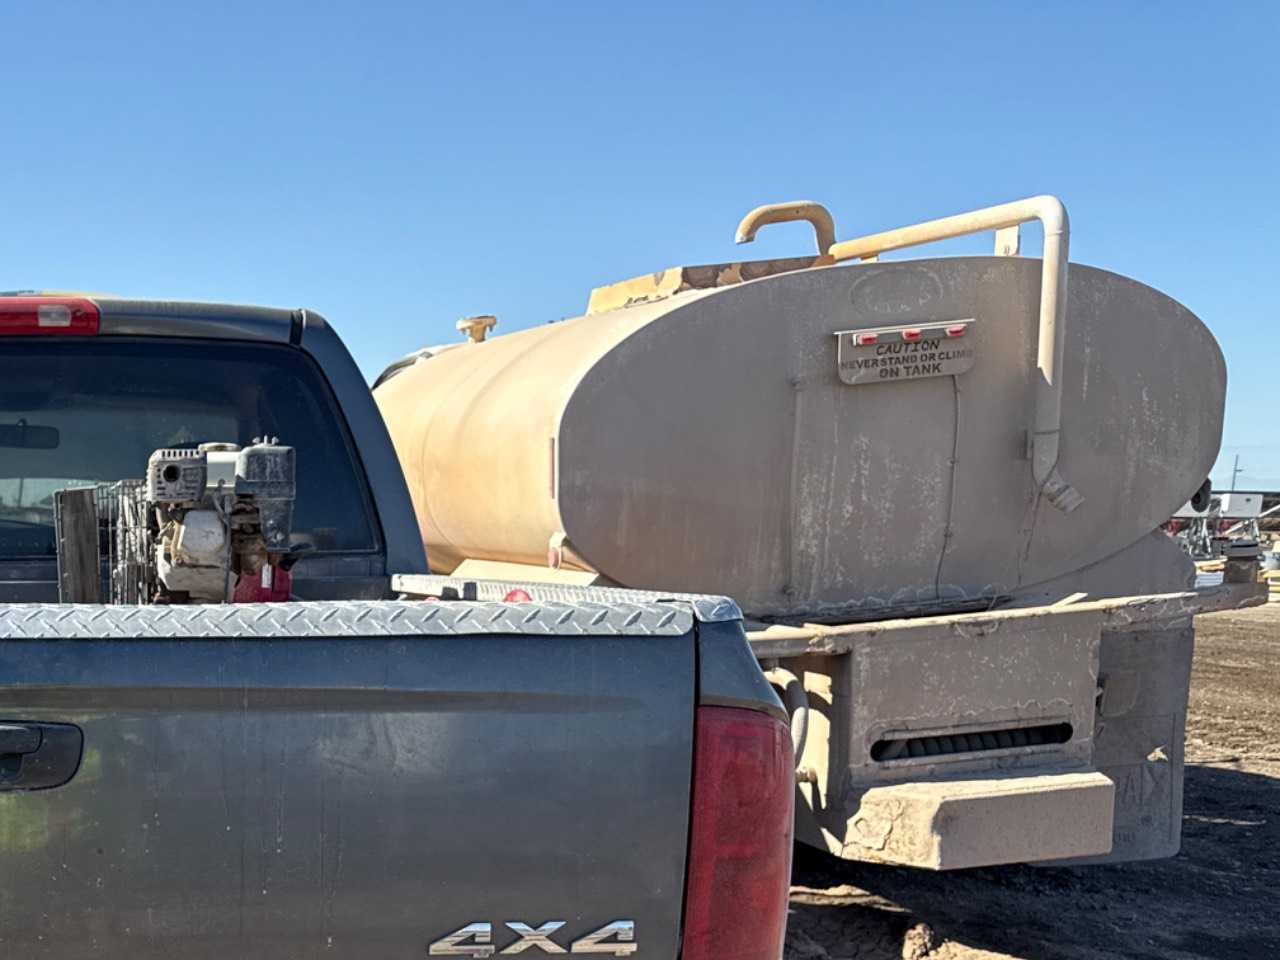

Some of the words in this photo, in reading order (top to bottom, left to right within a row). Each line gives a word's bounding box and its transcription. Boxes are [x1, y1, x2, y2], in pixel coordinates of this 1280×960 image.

[876, 339, 941, 356] CAUTION
[841, 357, 879, 370] NEVER
[880, 353, 918, 366] STAND
[919, 352, 937, 363] OR
[879, 367, 900, 379] ON
[903, 362, 942, 377] TANK
[428, 920, 638, 958] 4X4
